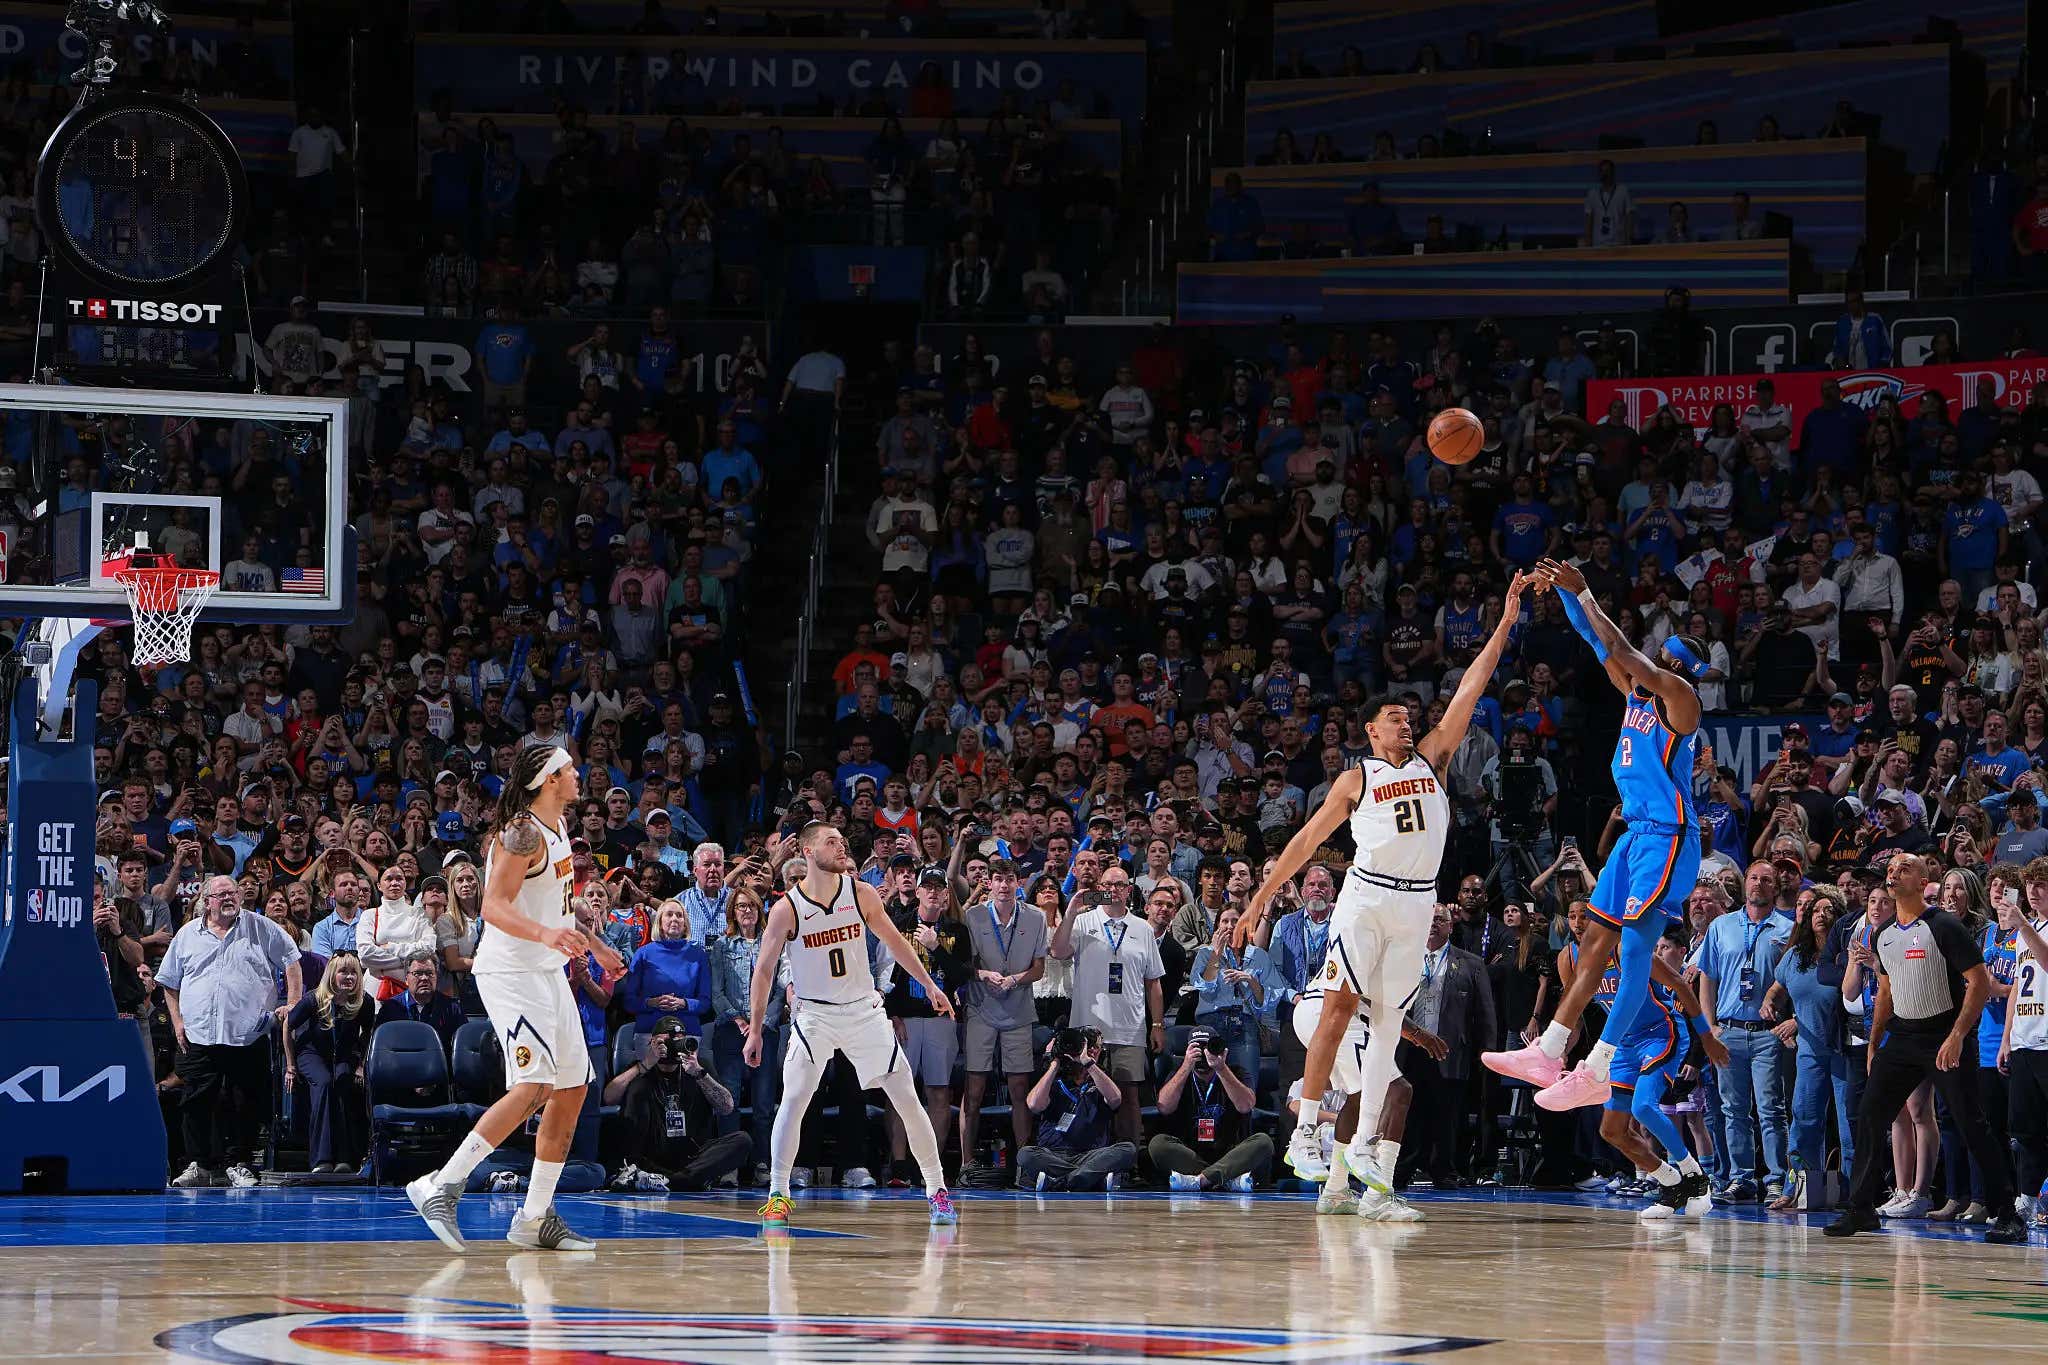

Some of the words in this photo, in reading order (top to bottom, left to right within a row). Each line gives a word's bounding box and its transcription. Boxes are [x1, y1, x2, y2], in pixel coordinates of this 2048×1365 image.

[58, 31, 219, 66] CSIN
[847, 59, 1044, 90] CAINO
[111, 300, 222, 324] TISSOT
[1620, 736, 1633, 768] 2
[1372, 777, 1436, 804] NUGGETS
[446, 821, 459, 831] 42
[1393, 799, 1425, 834] 21
[38, 822, 75, 853] GET
[37, 856, 75, 887] THE
[45, 890, 83, 928] App
[802, 922, 861, 950] NUGGETS
[828, 947, 846, 977] 0
[2021, 965, 2035, 998] 2
